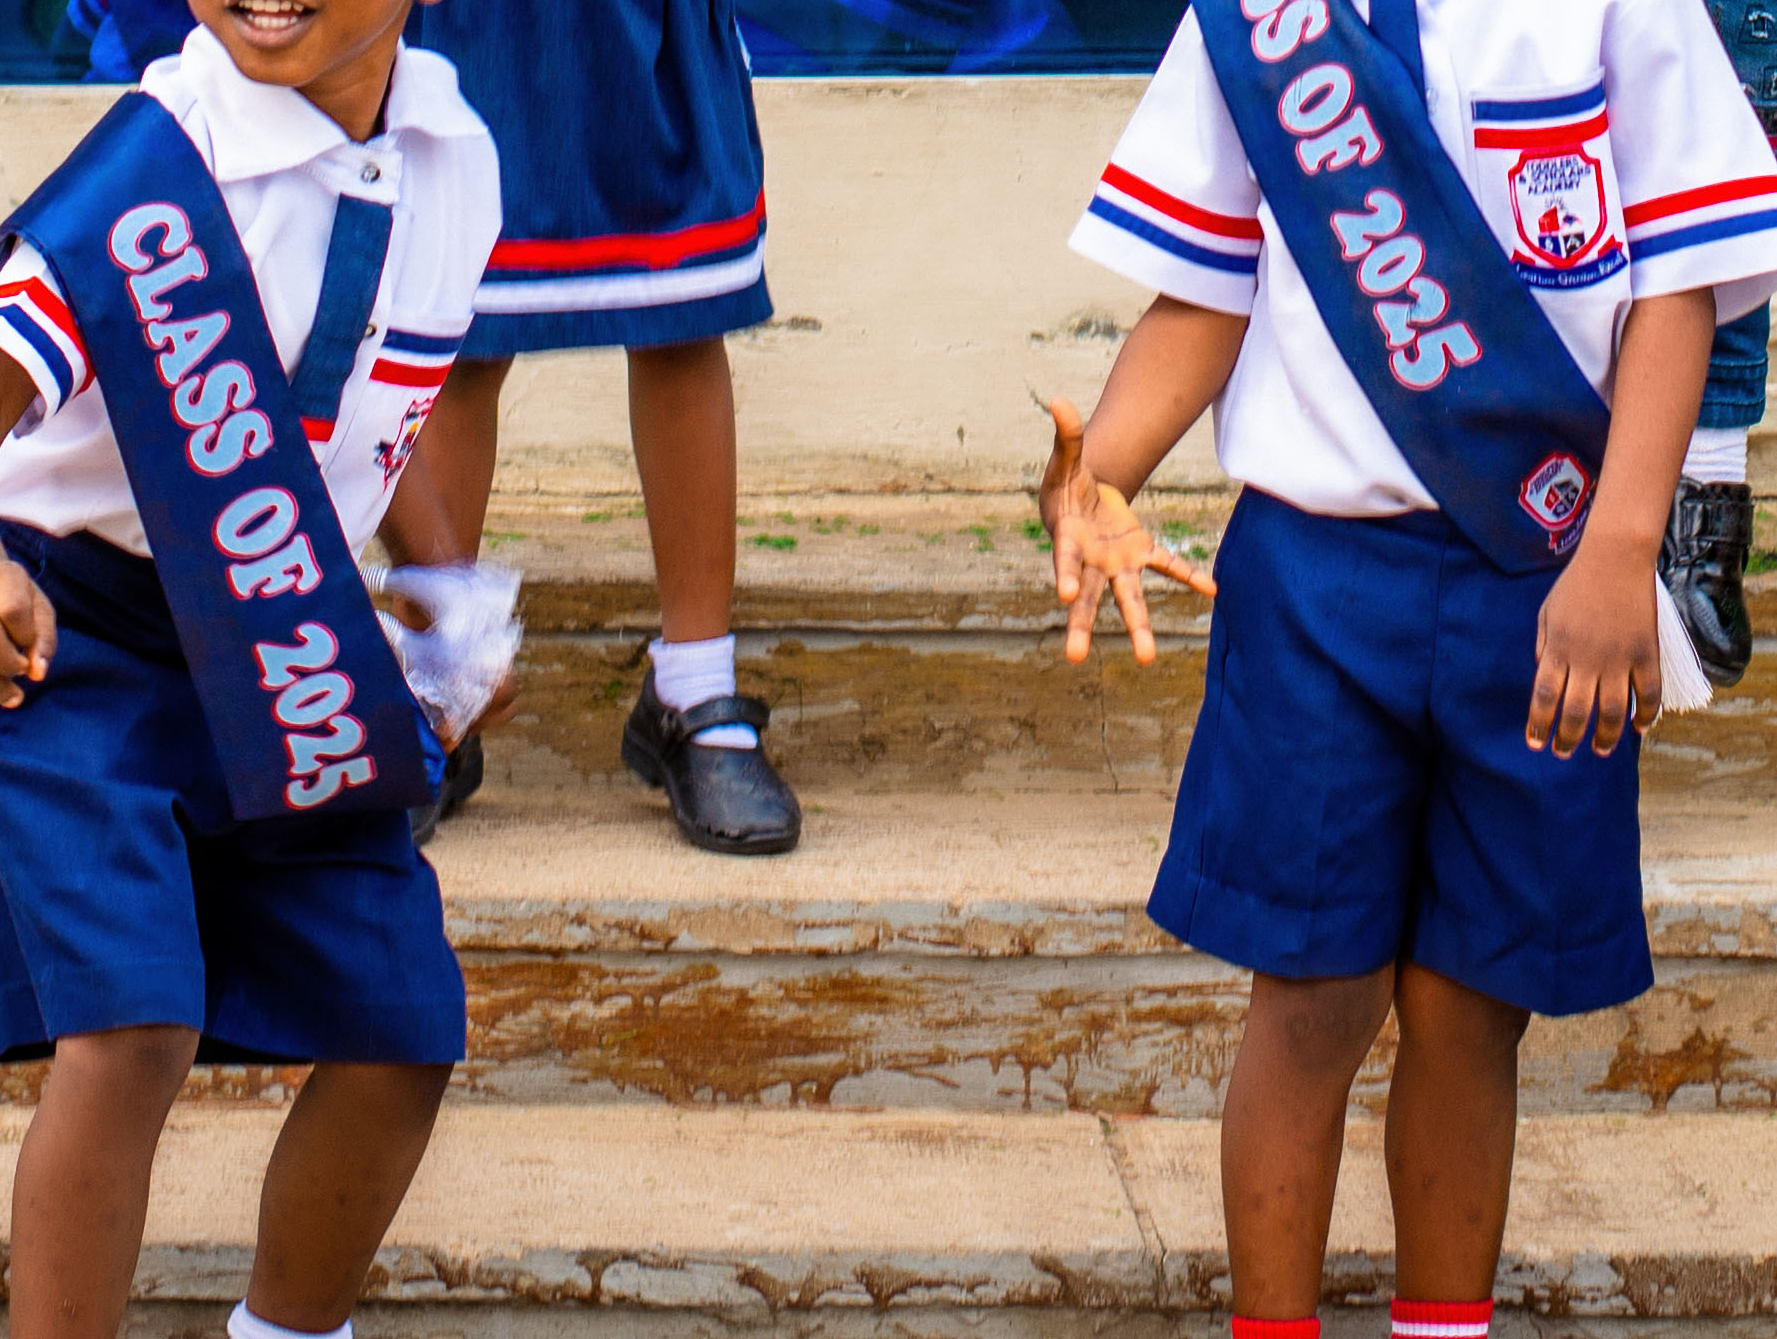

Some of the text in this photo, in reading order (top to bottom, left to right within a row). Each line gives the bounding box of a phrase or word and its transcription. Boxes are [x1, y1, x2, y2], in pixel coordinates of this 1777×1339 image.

[1278, 62, 1383, 175] OF
[1330, 188, 1483, 390] 2025
[109, 200, 377, 811] CLASS OF 2025
